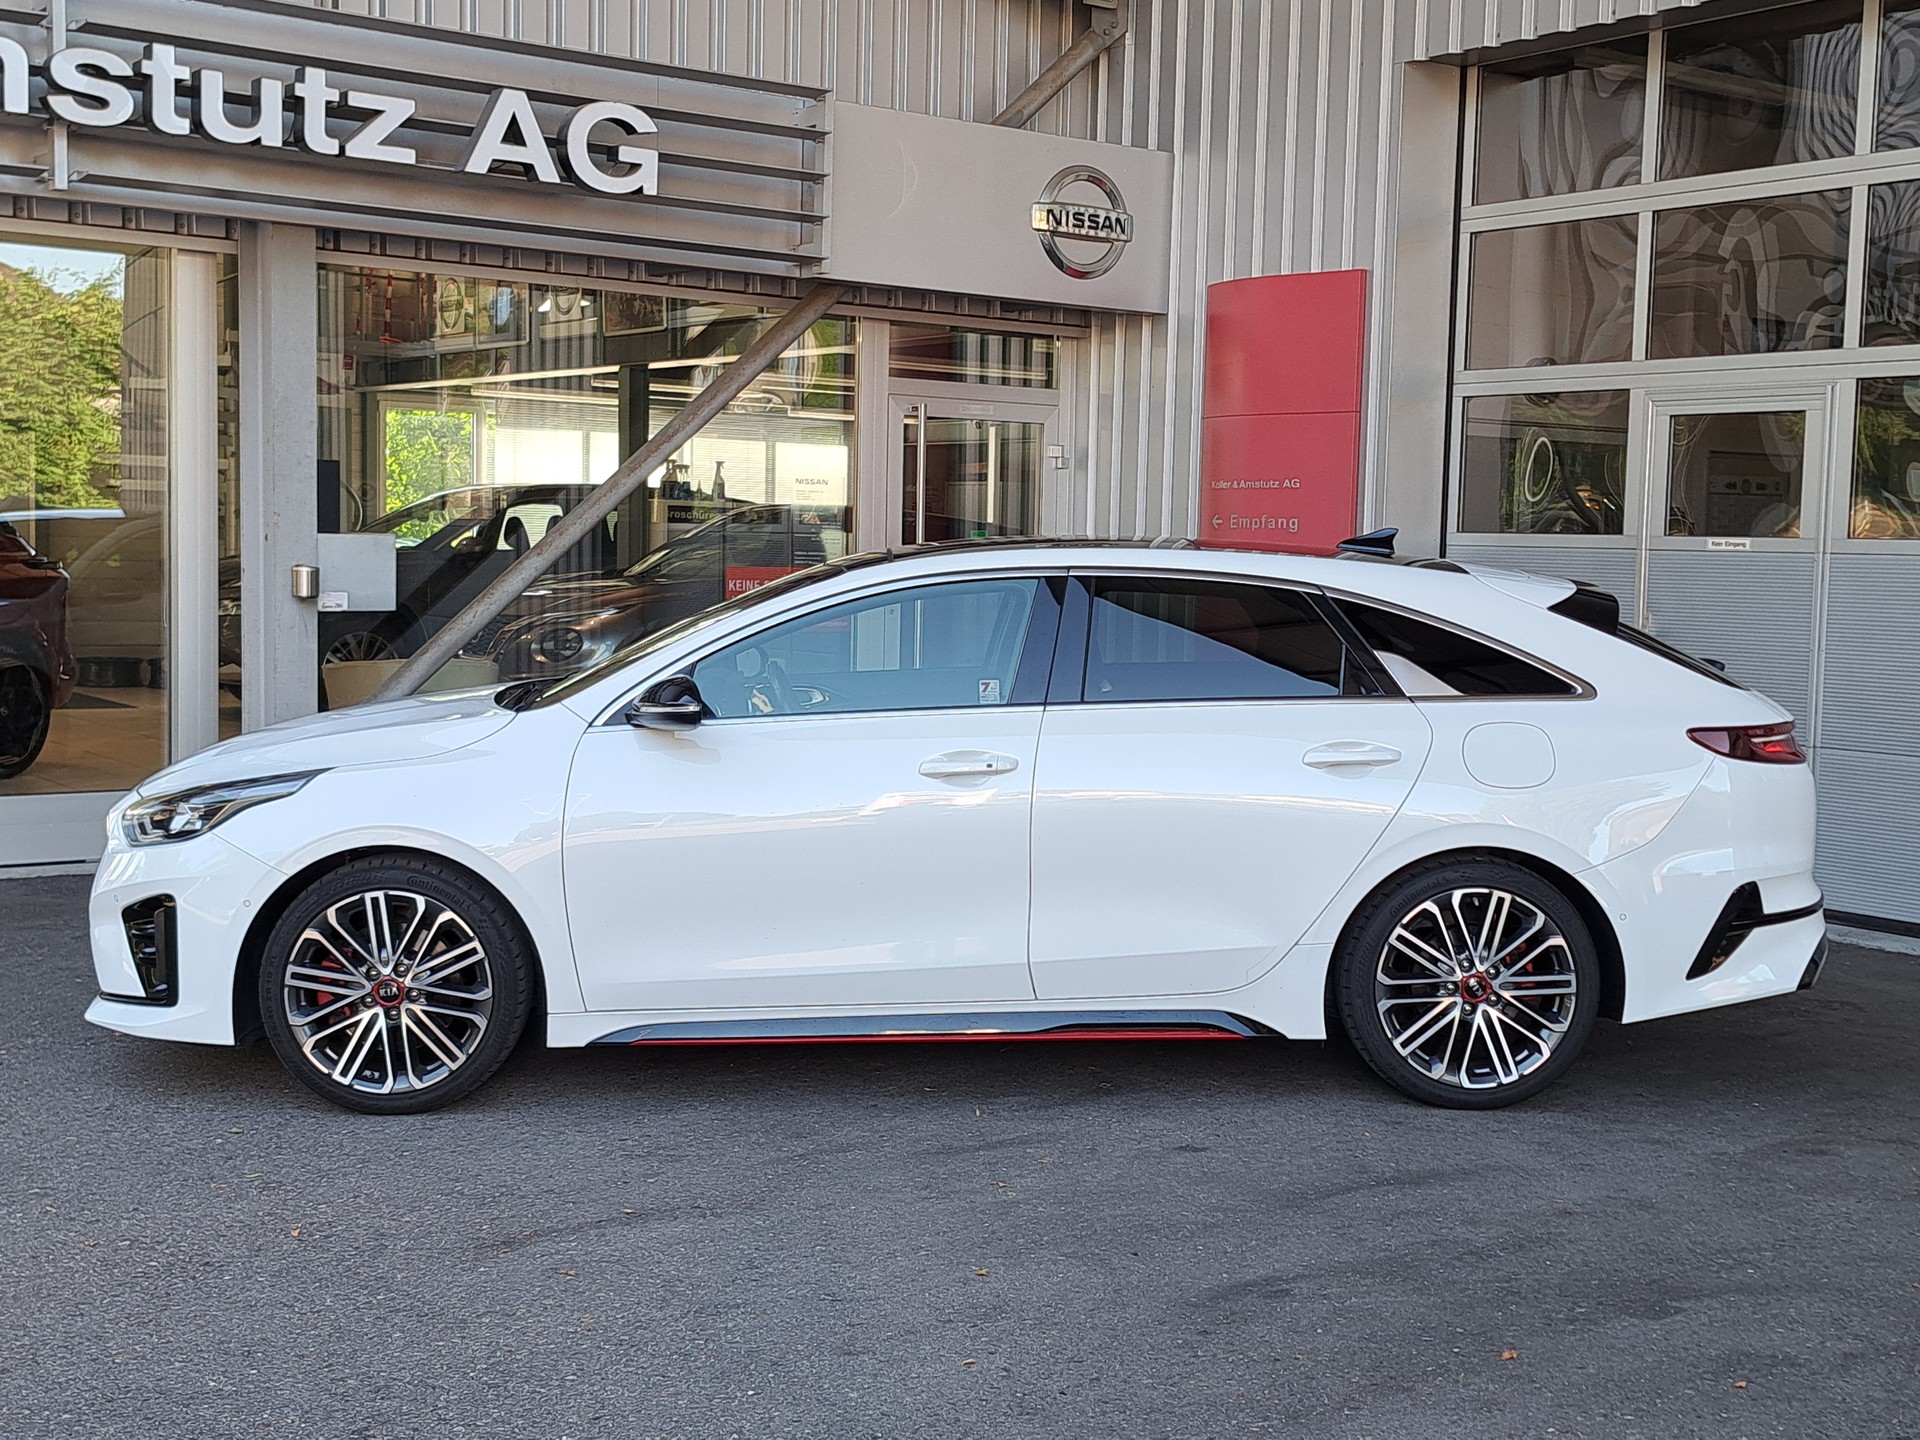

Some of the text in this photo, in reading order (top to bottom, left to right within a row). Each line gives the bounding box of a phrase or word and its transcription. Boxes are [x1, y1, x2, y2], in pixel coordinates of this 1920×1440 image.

[462, 88, 660, 196] AG
[1045, 208, 1126, 235] NISSAN
[795, 478, 829, 486] NISSAN
[1231, 479, 1239, 489] &
[1239, 479, 1280, 489] Amstutz
[1282, 478, 1301, 488] AG
[667, 509, 717, 520] roschüre
[1230, 513, 1299, 532] Empfang
[728, 579, 760, 592] KEINE
[407, 875, 465, 908] Continental
[379, 986, 399, 997] KIA
